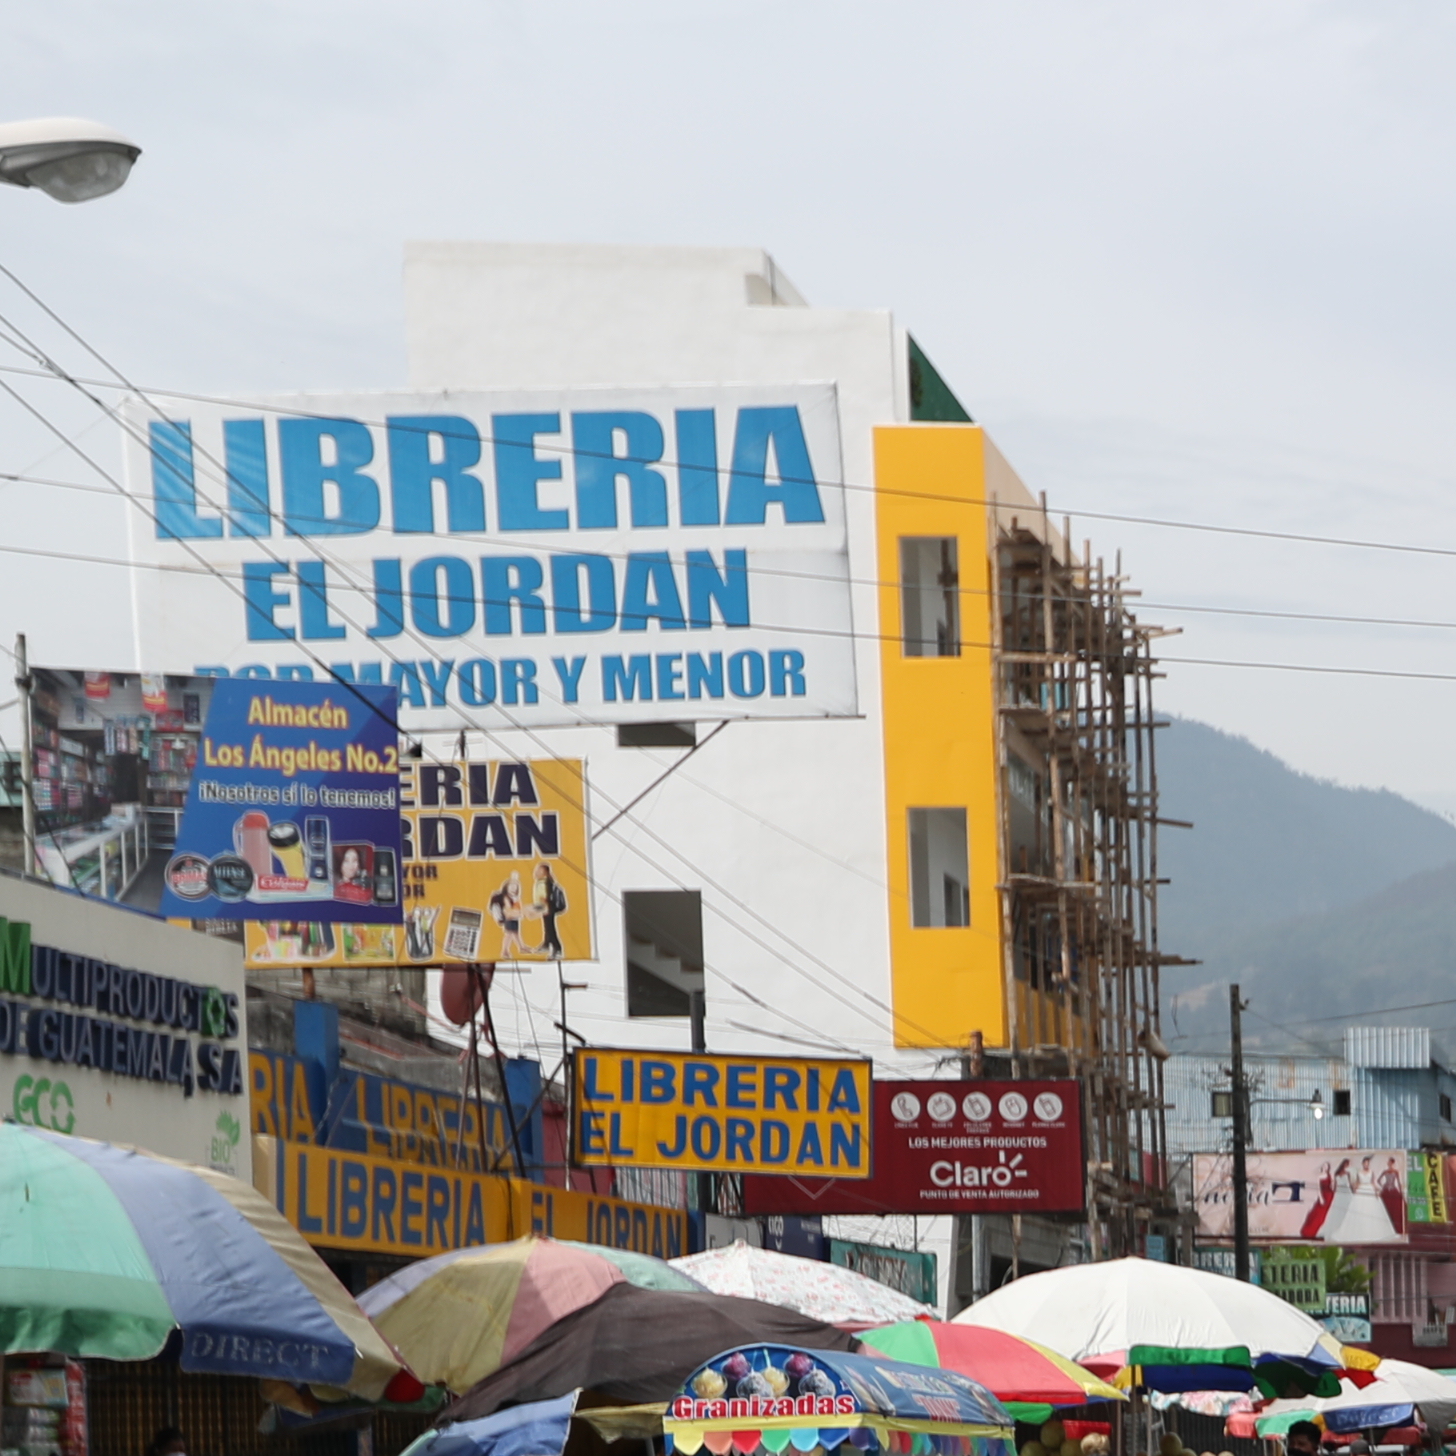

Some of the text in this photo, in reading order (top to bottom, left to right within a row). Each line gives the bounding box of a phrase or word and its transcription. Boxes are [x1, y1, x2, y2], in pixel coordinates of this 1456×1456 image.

[149, 406, 824, 539] LIBRERIA
[243, 548, 750, 641] EL JORDAN
[552, 656, 586, 704] Y
[603, 648, 806, 699] MENOR
[248, 696, 348, 729] Almacén
[204, 734, 398, 777] Los Ángeles No.2
[301, 784, 317, 805] lo
[583, 1056, 861, 1114] LIBRERIA
[580, 1111, 861, 1169] EL JORDAN
[908, 1135, 1047, 1149] LOS MEJORES PRODUCTOS
[930, 1158, 1014, 1188] Claro
[299, 1151, 486, 1251] LIBRERIA
[190, 1331, 332, 1371] DIRECT
[672, 1393, 856, 1421] Granizadas
